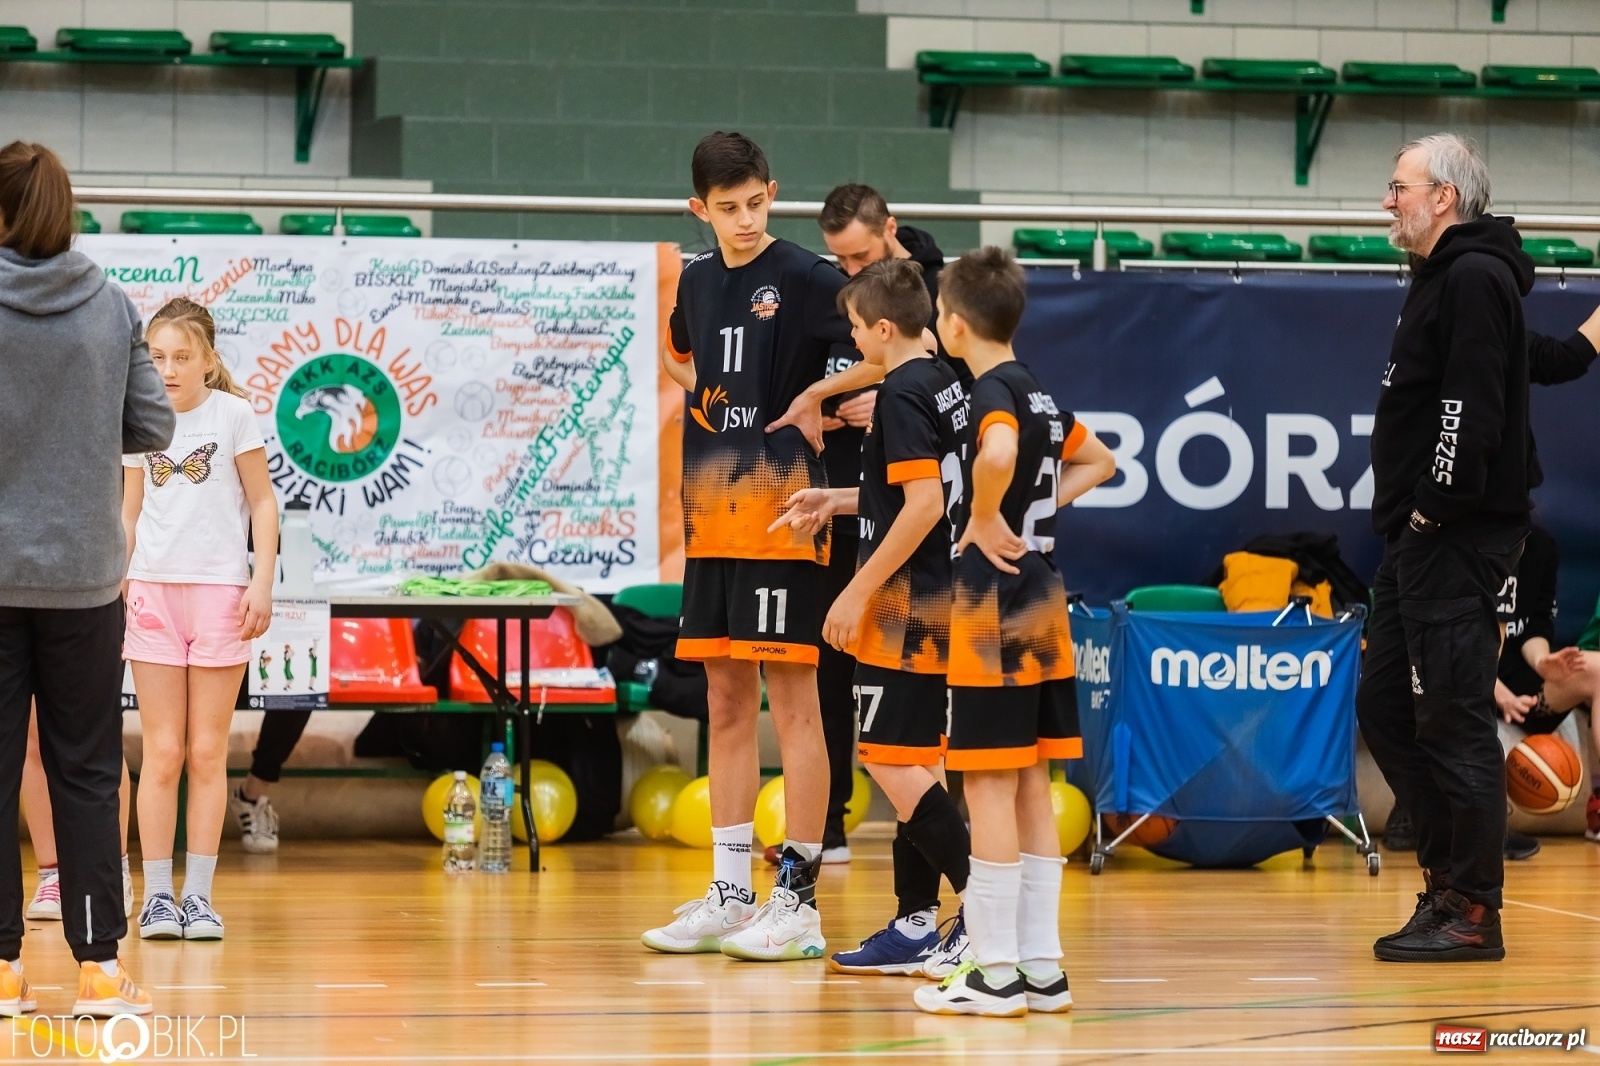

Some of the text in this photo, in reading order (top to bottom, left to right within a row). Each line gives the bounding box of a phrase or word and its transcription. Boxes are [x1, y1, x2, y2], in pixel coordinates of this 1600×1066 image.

[103, 256, 203, 283] rzenaN
[246, 316, 438, 418] GRAMY DLA WAS
[719, 327, 744, 373] 11
[289, 358, 389, 397] RKK AZS
[721, 406, 758, 433] JSW
[287, 436, 392, 480] RACIBÓRZ
[528, 538, 636, 579] CezaryS
[755, 587, 787, 634] 11
[752, 646, 787, 655] DAMONS
[1151, 645, 1332, 691] molten
